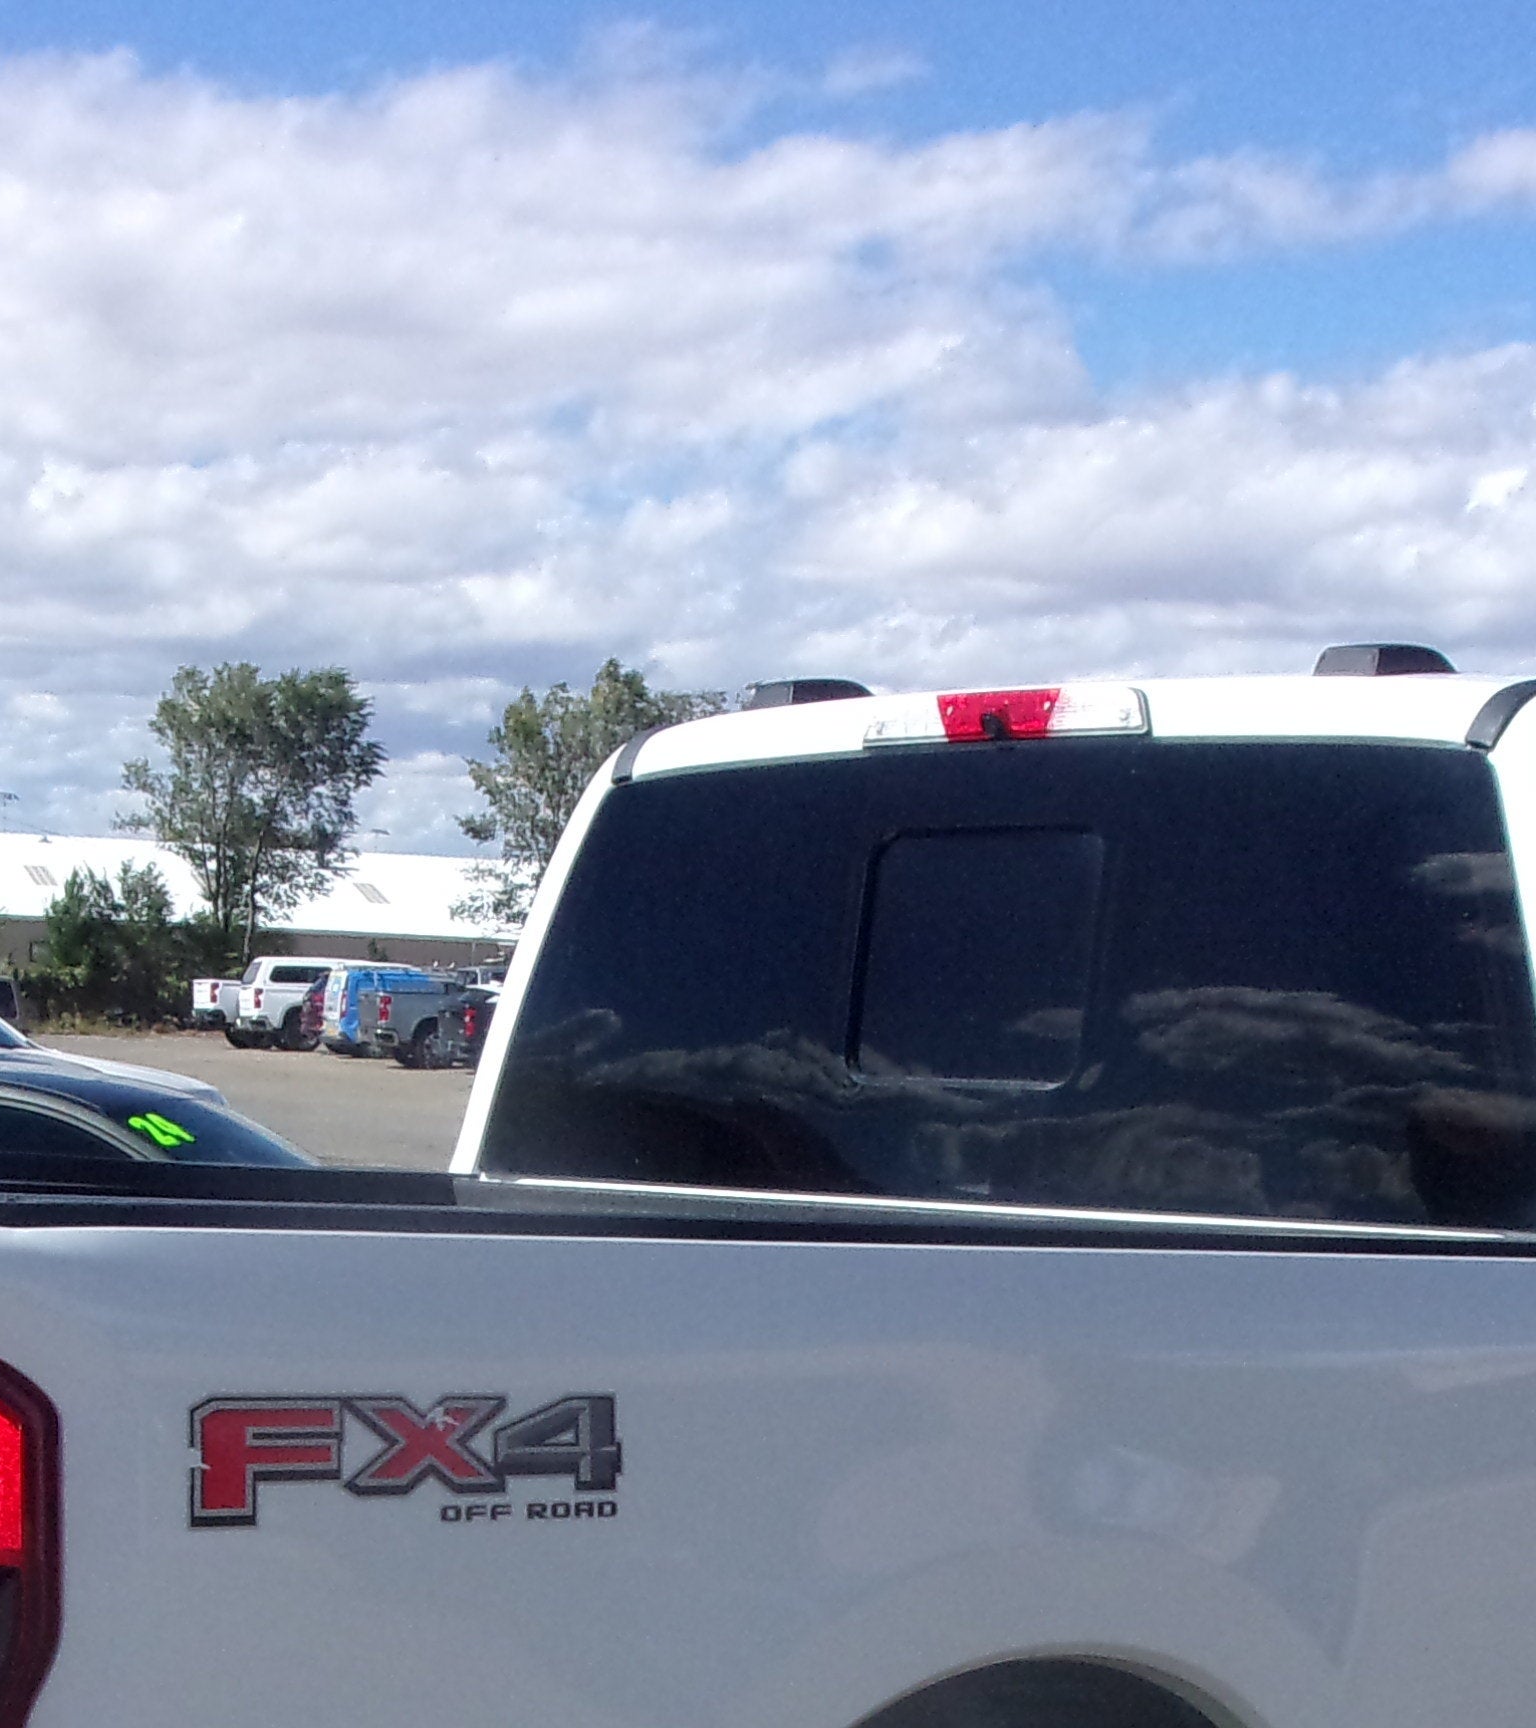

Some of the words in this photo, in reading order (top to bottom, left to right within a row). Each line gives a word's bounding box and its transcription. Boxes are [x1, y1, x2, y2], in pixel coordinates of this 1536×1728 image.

[128, 1113, 195, 1146] 24
[190, 1396, 622, 1527] FX4
[440, 1504, 513, 1523] OFF
[527, 1500, 619, 1520] ROAD
